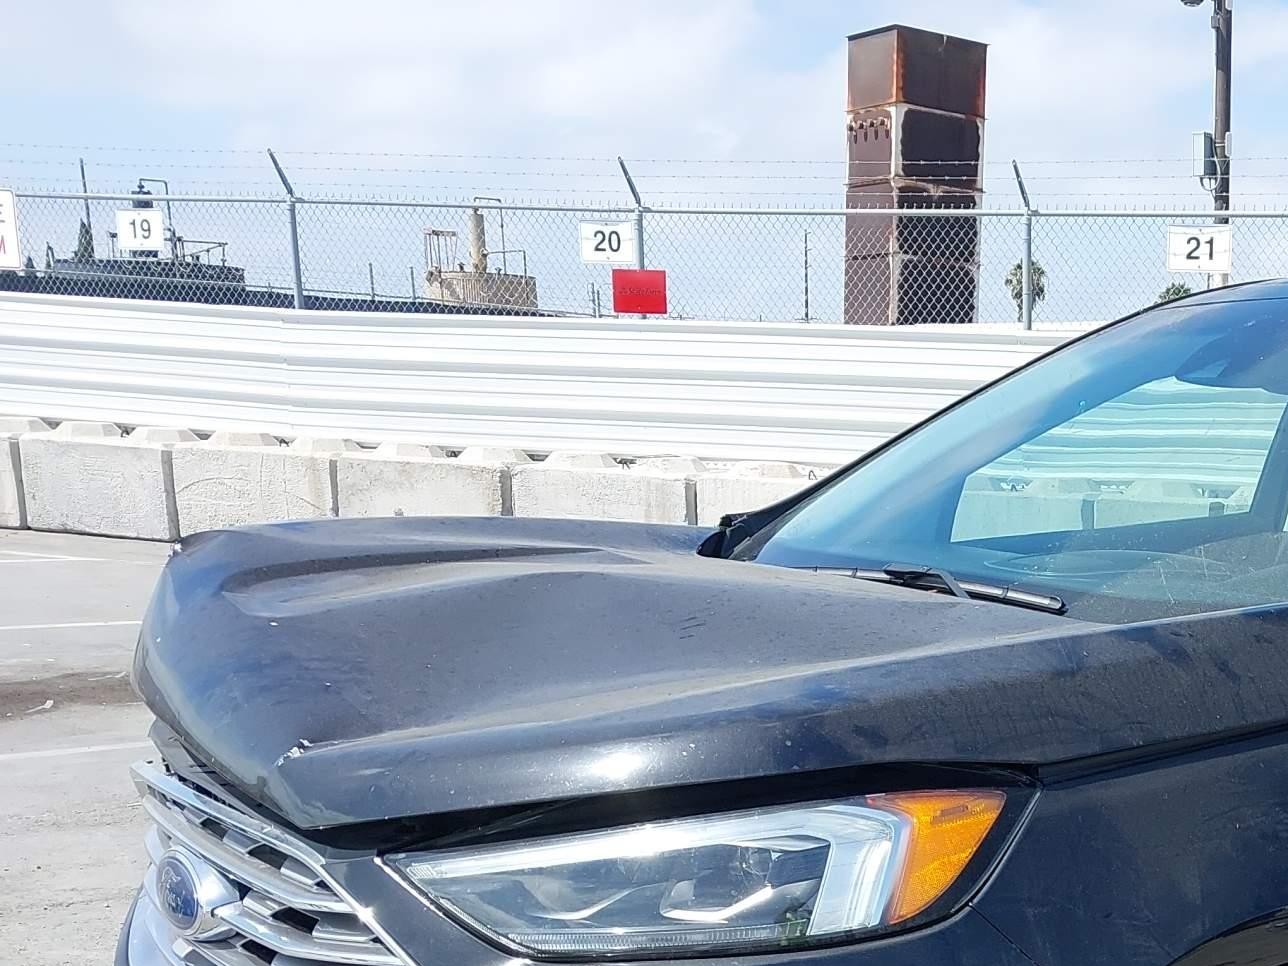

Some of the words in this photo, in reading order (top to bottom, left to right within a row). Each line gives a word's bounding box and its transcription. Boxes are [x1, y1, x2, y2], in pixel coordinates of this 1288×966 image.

[129, 218, 151, 240] 19
[593, 230, 621, 252] 20
[1186, 236, 1214, 260] 21
